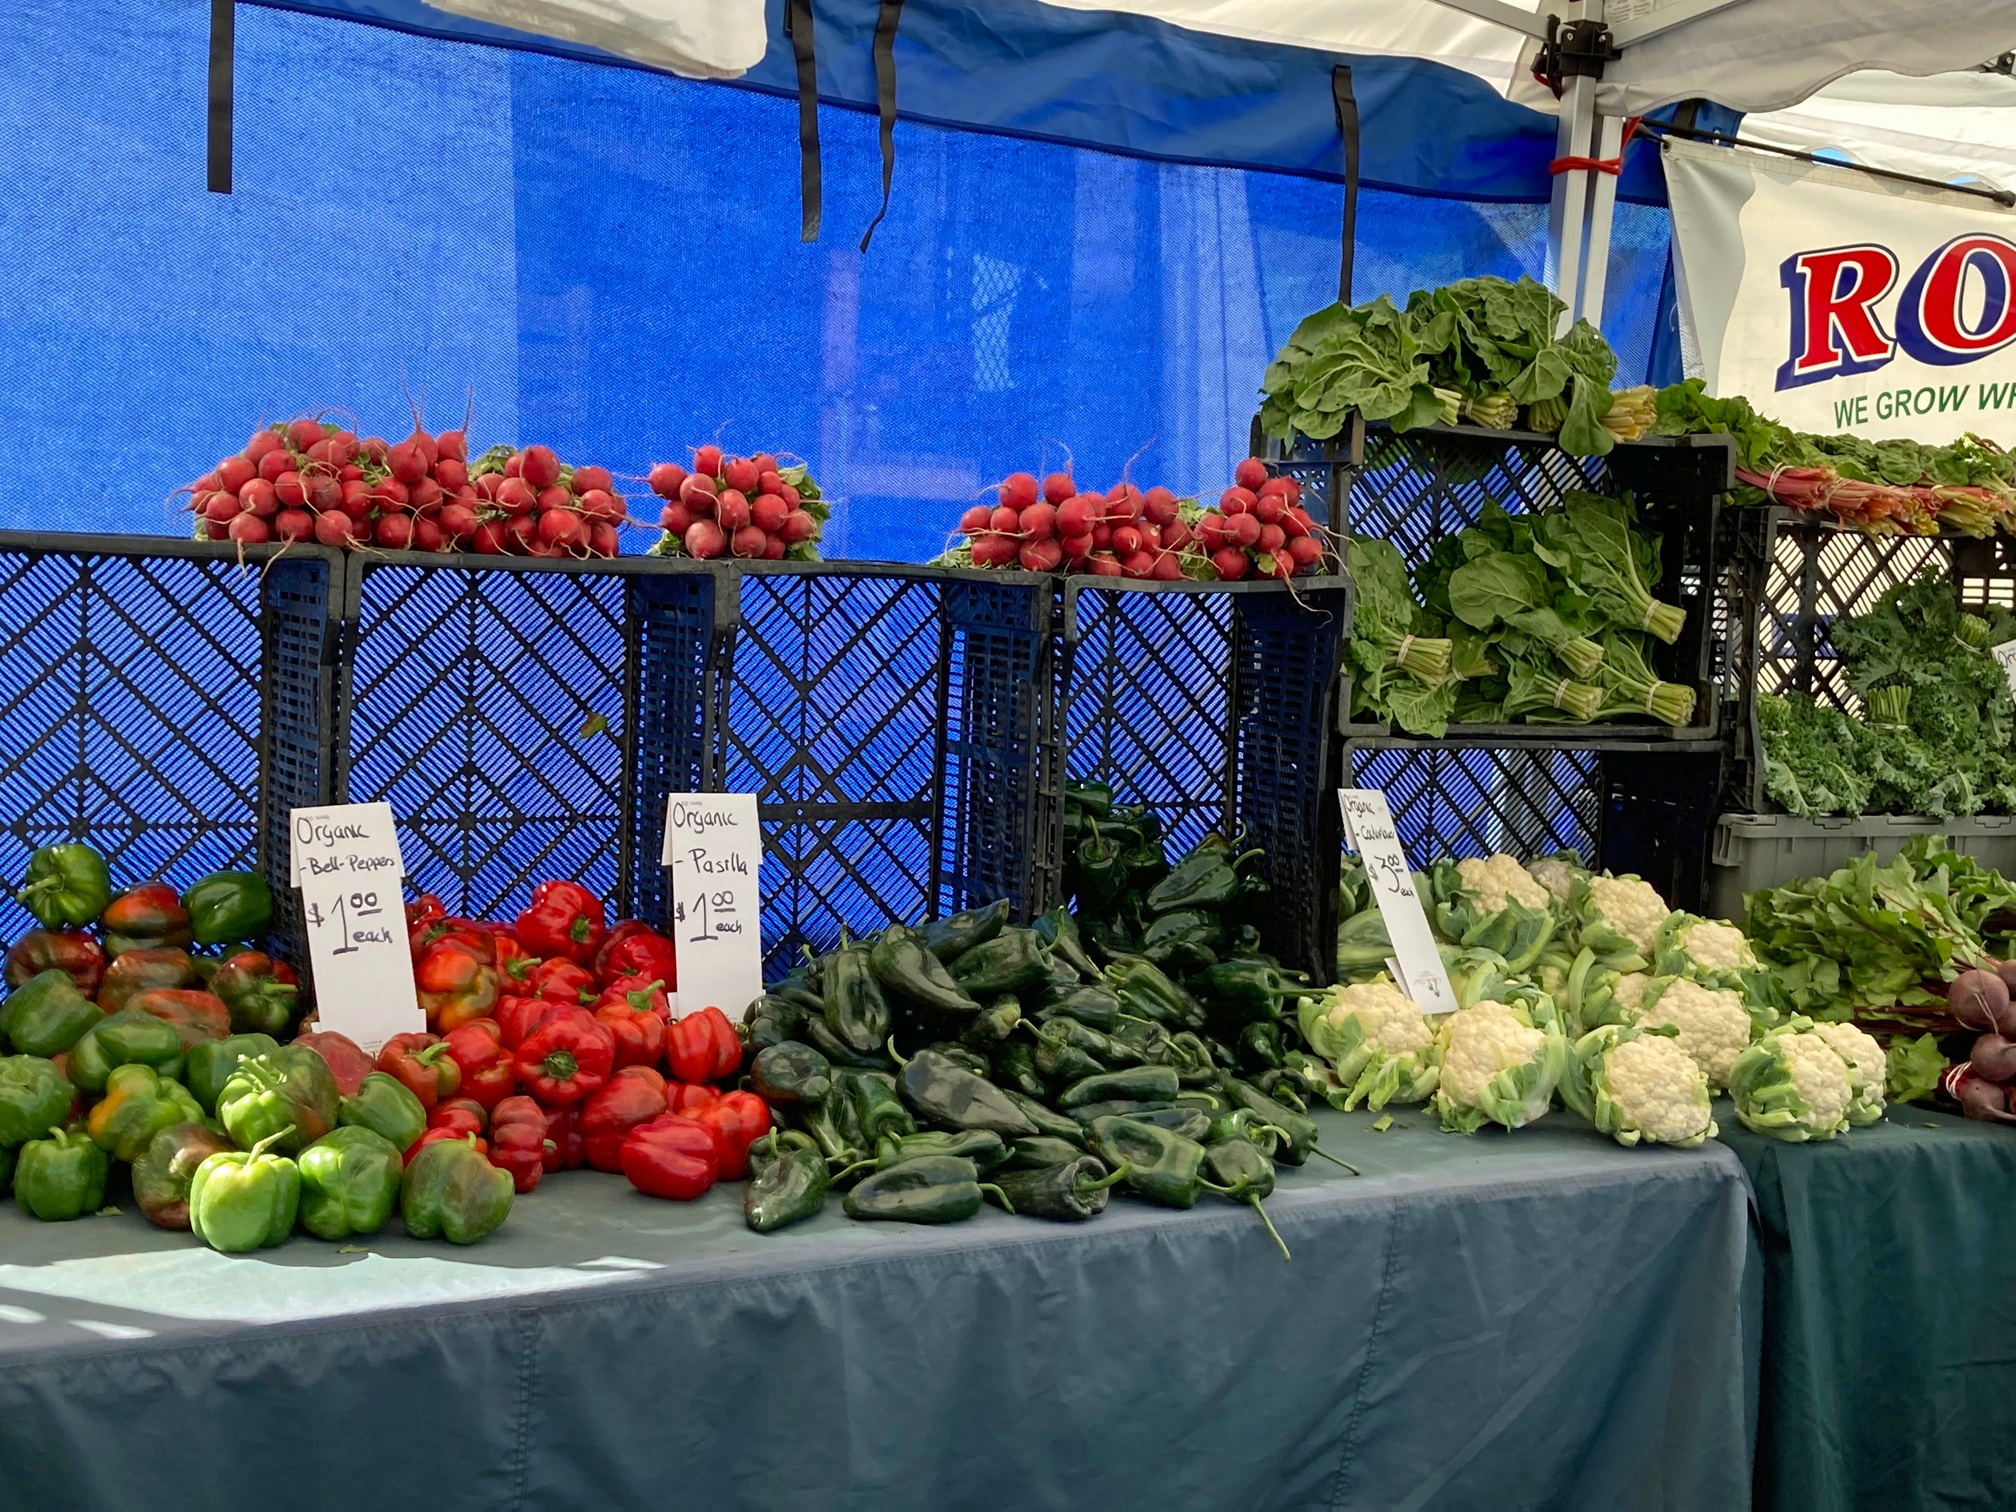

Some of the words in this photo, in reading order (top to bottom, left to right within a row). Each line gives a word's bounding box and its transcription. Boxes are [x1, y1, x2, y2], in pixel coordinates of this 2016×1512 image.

[1834, 395, 1868, 429] WE
[1876, 384, 1970, 420] GROW
[297, 816, 370, 847] Organic
[673, 802, 738, 834] Organic
[353, 926, 393, 944] each
[715, 920, 742, 934] each
